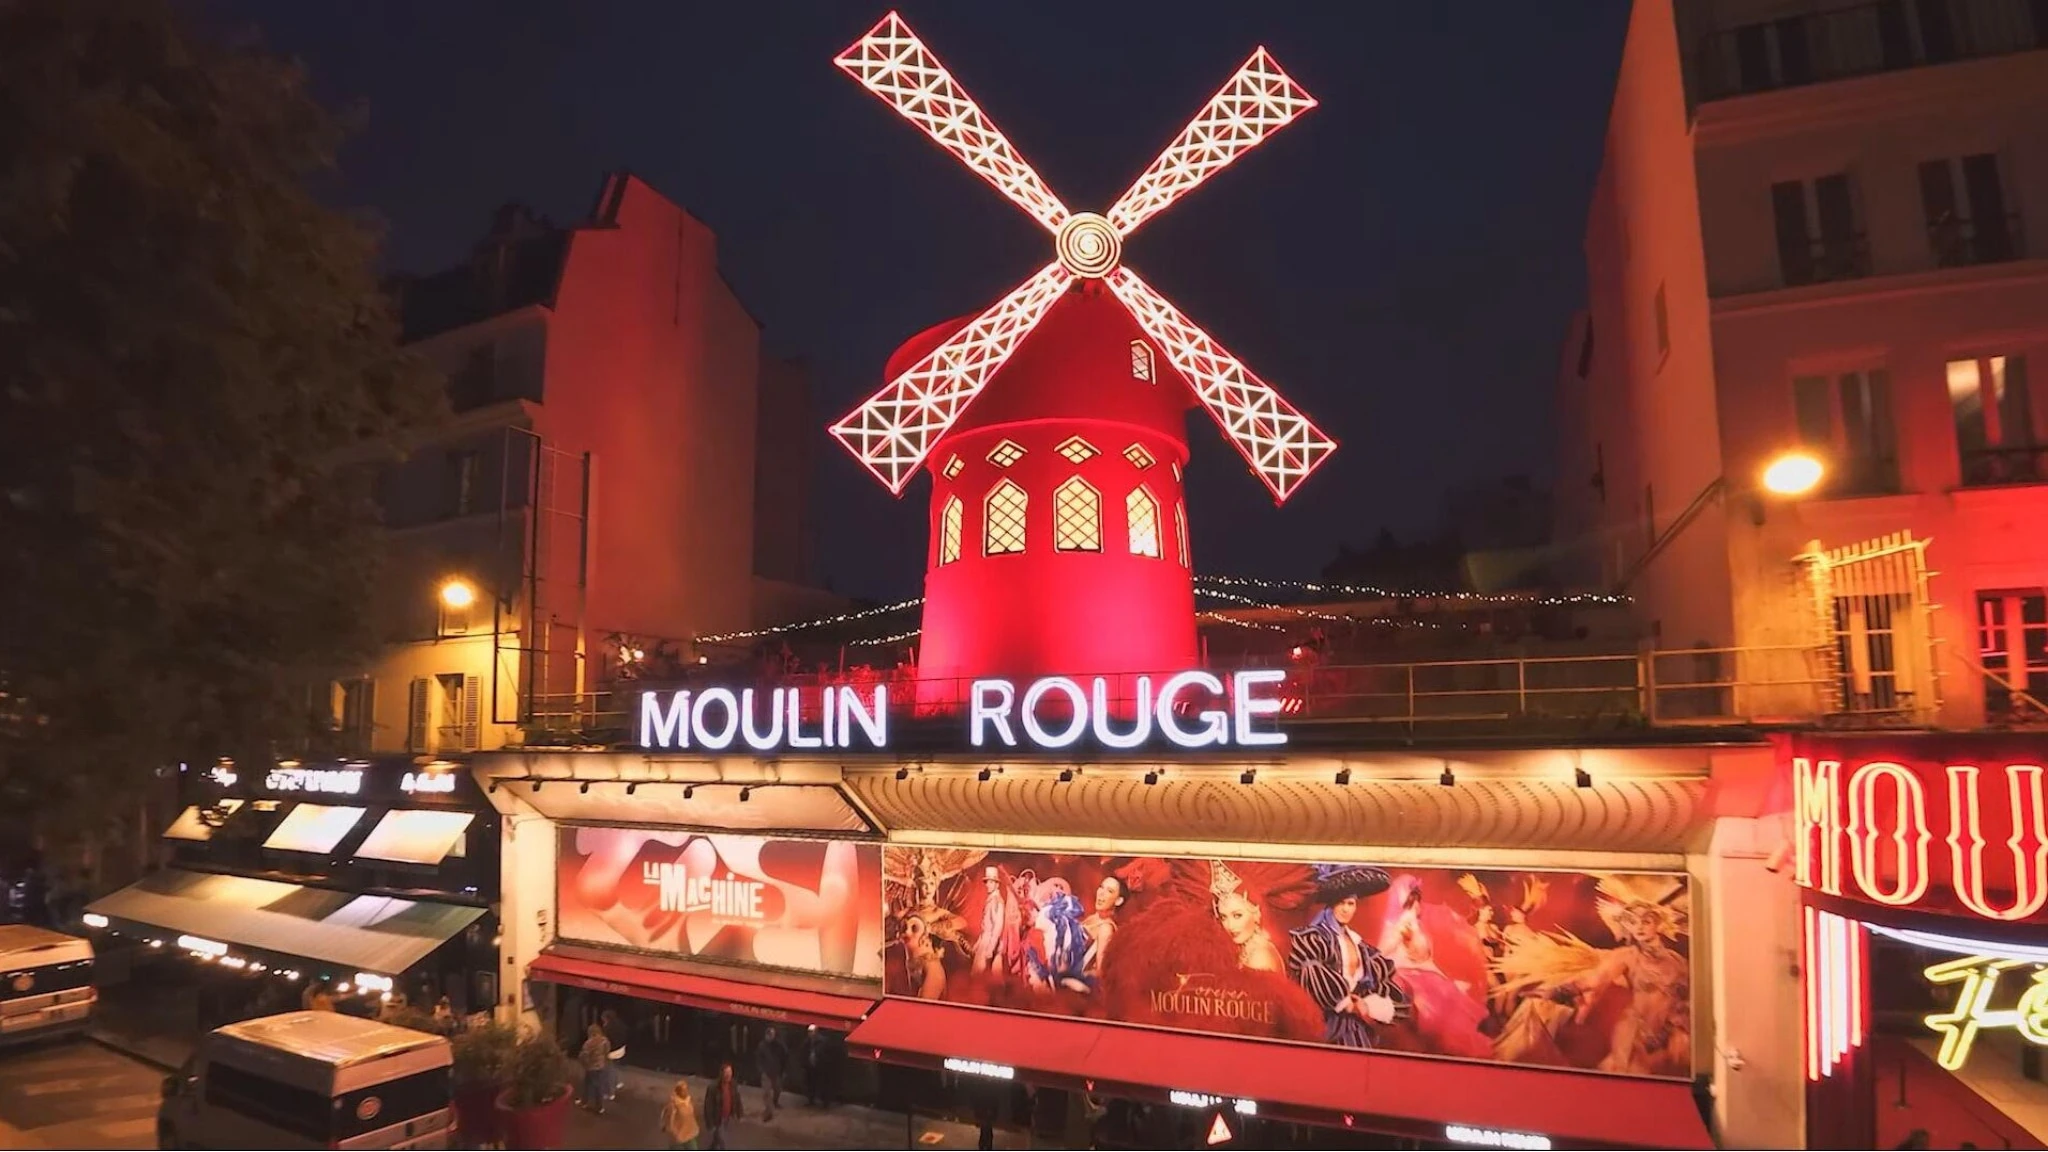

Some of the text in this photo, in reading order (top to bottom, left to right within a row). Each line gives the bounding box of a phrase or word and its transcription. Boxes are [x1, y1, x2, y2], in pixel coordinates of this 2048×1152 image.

[640, 669, 1289, 750] MOULIN ROUGE
[643, 861, 660, 884] LA
[1149, 989, 1275, 1024] MOULIN ROUGE
